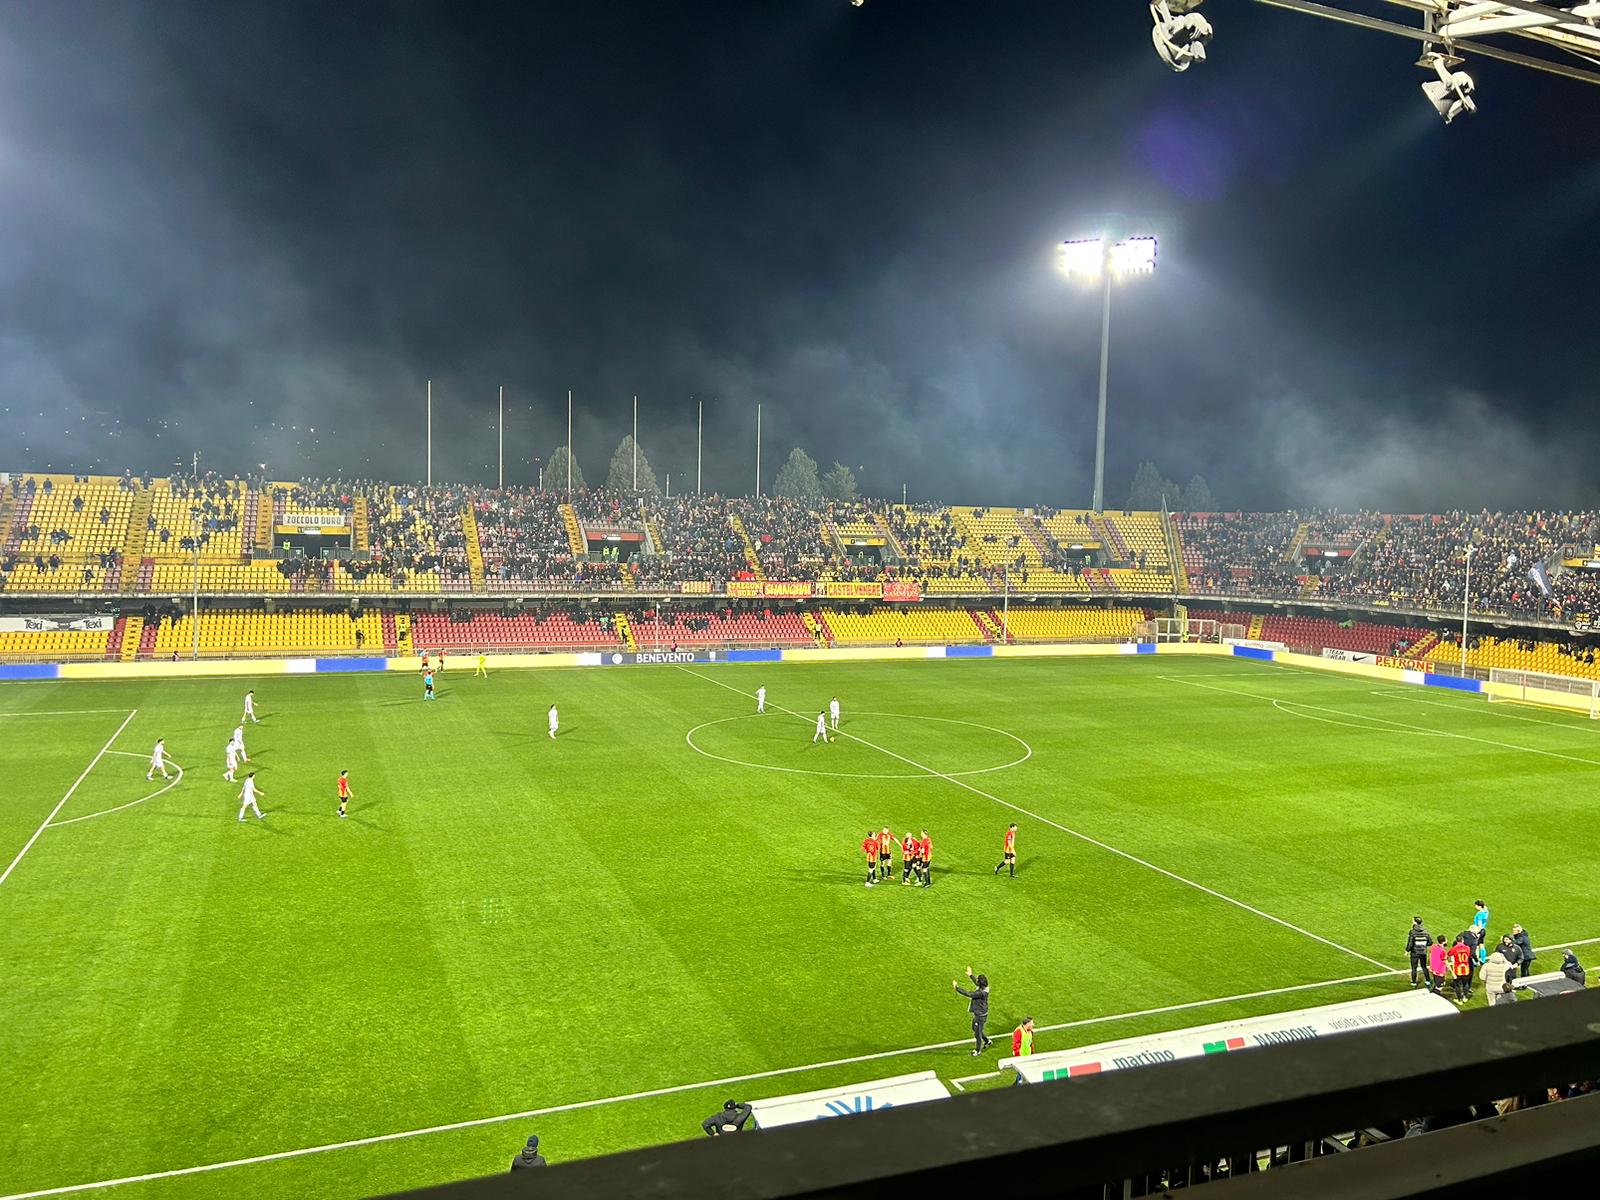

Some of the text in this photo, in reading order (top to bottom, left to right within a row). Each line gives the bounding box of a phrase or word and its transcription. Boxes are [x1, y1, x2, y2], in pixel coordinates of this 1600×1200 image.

[287, 516, 341, 525] ZOCCOLO DURO
[24, 619, 43, 630] Texi
[83, 618, 102, 629] Texi
[636, 652, 695, 664] BENEVENTO
[1376, 655, 1434, 674] PETRONE
[1457, 952, 1468, 963] 10
[1367, 1010, 1403, 1024] nostro
[1113, 1050, 1175, 1069] martino
